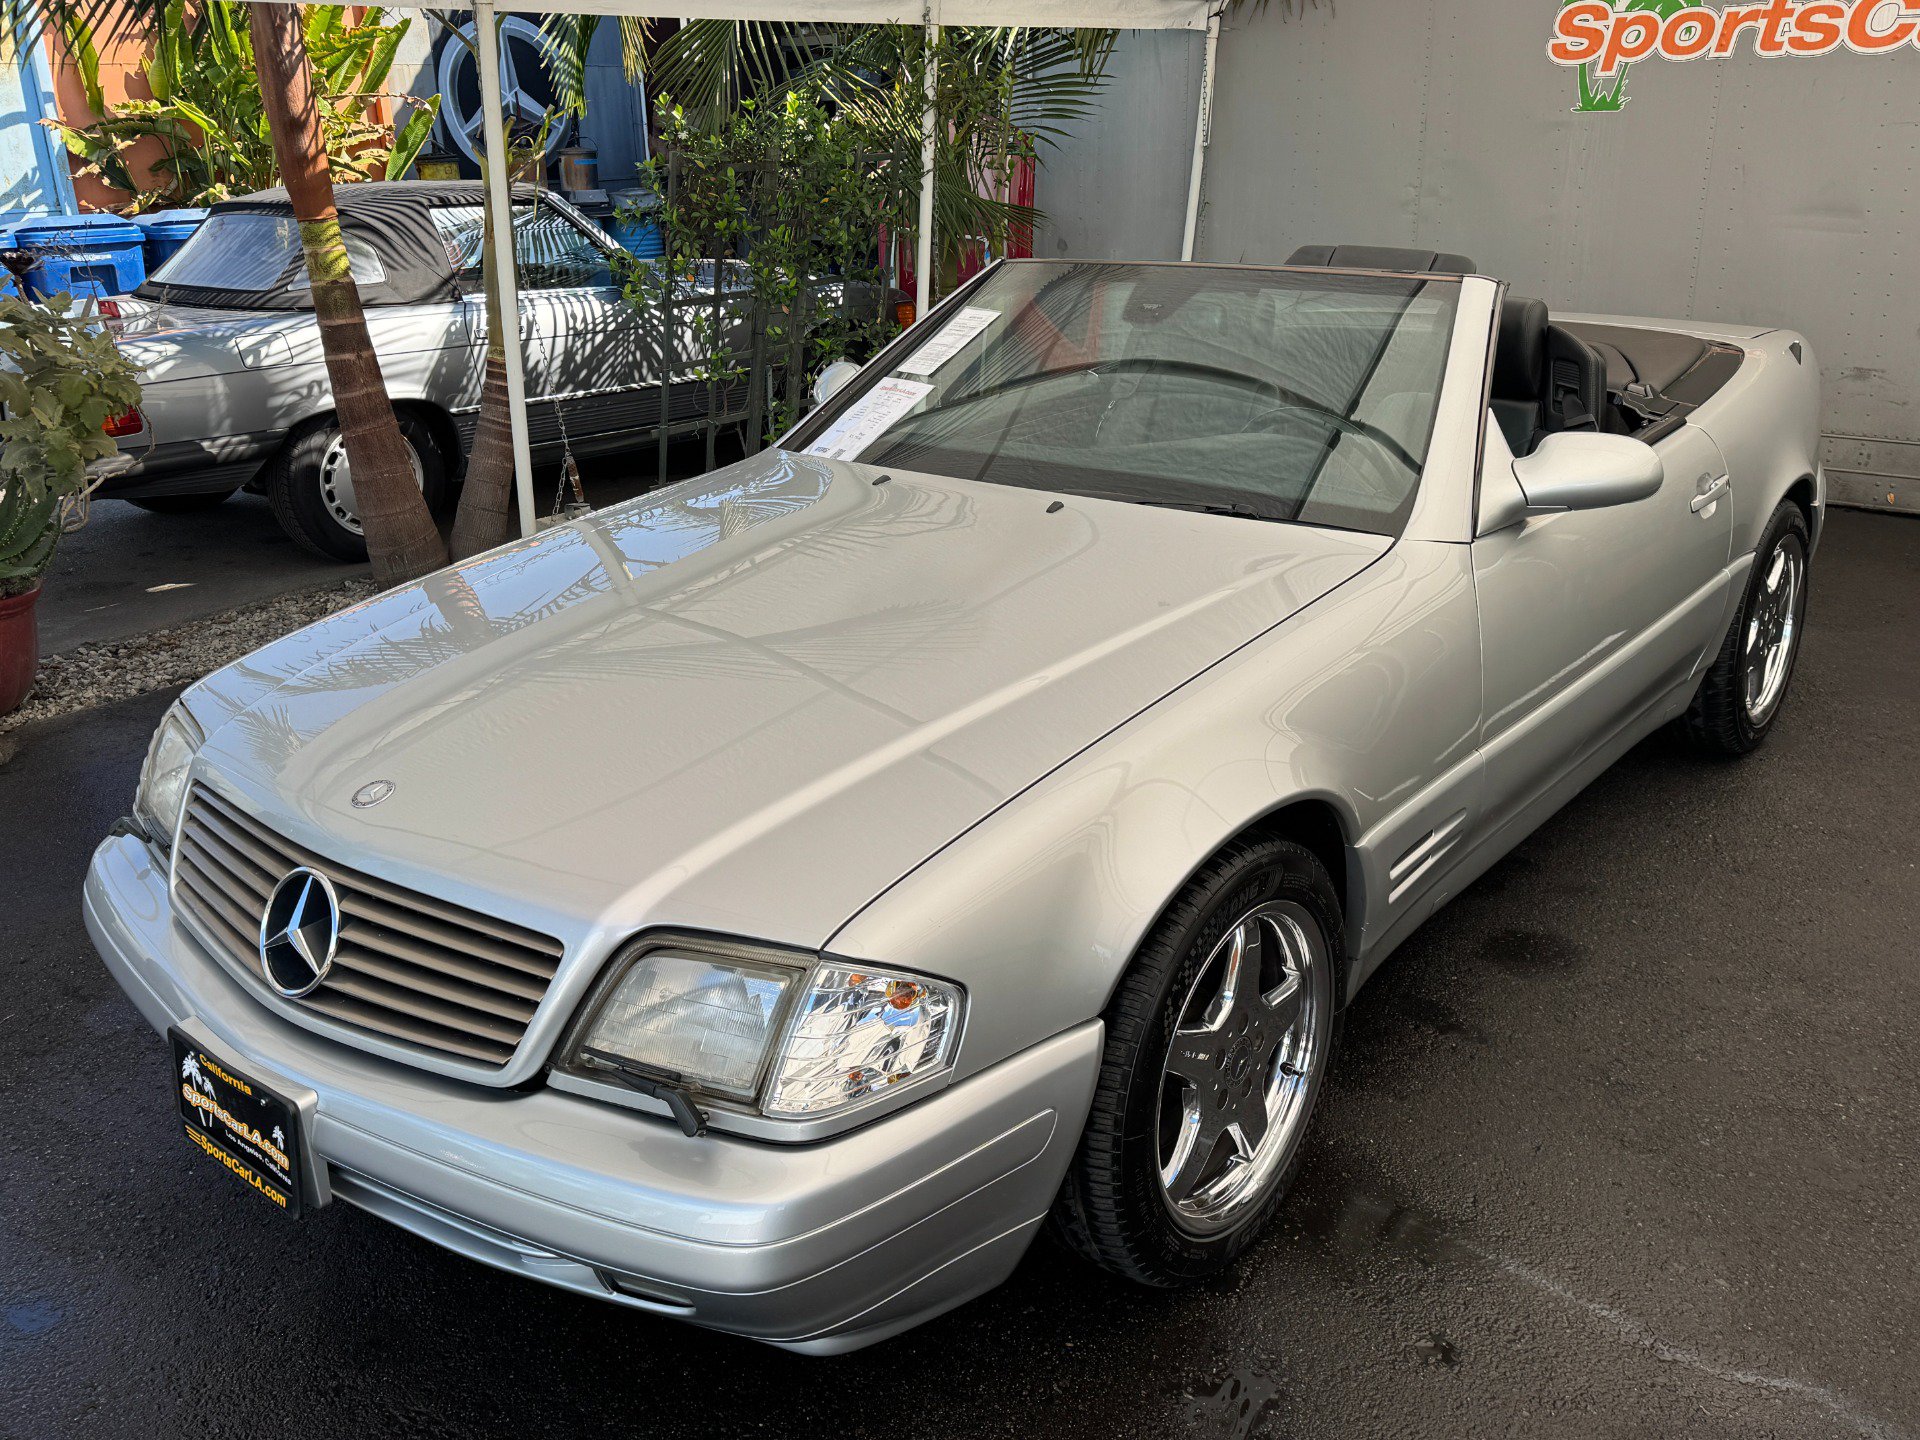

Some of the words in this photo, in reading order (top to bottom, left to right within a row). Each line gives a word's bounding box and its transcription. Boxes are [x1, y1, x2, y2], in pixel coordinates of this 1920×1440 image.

[1552, 0, 1920, 72] SportsC
[199, 1053, 252, 1096] California
[183, 1084, 289, 1170] SportsCarLA.com
[200, 1135, 287, 1209] SportsCarLA.com
